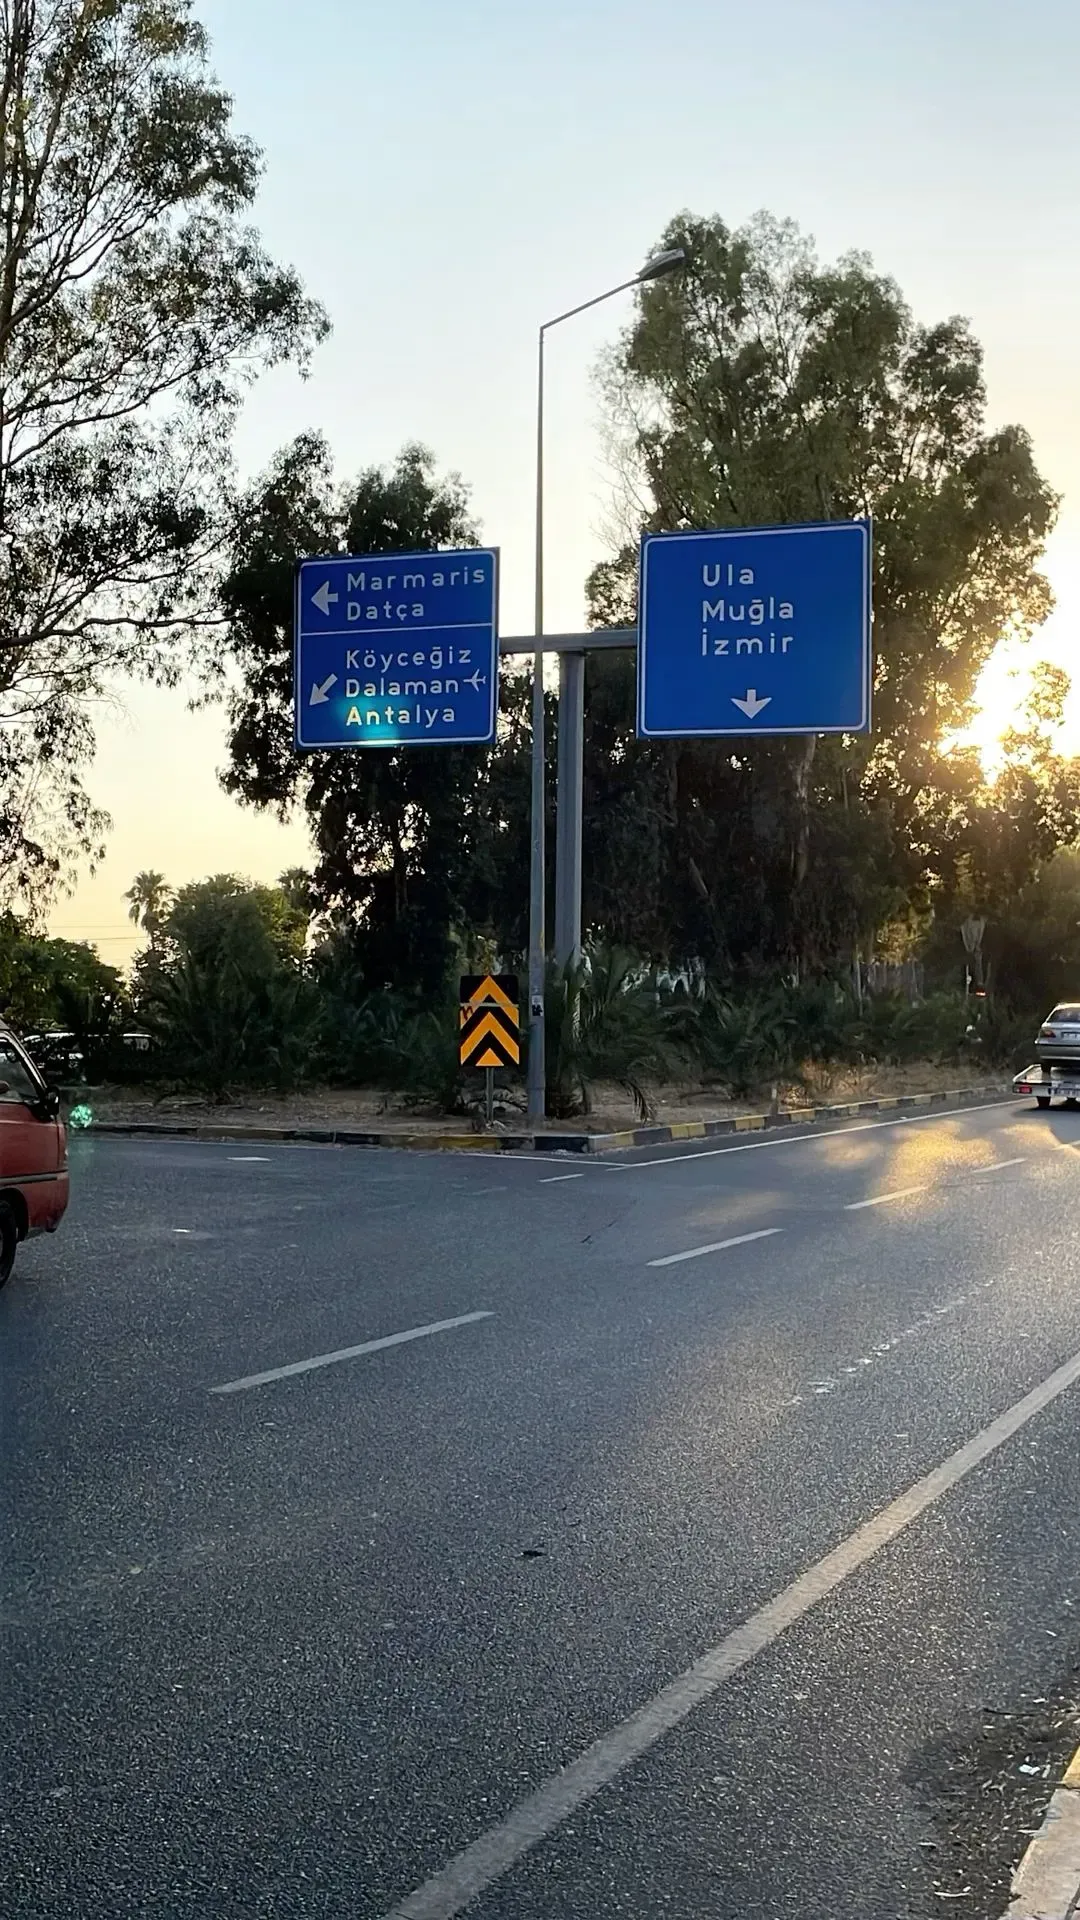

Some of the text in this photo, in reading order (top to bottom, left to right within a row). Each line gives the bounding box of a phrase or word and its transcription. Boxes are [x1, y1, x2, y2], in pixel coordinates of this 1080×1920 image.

[347, 566, 485, 592] Marmaris
[702, 564, 755, 587] Ula
[347, 601, 425, 621] Datça
[702, 596, 794, 626] Muğla
[701, 628, 794, 656] İzmir
[346, 646, 472, 673] Köyceğiz
[345, 677, 459, 698] Dalaman
[346, 704, 456, 729] Antalya
